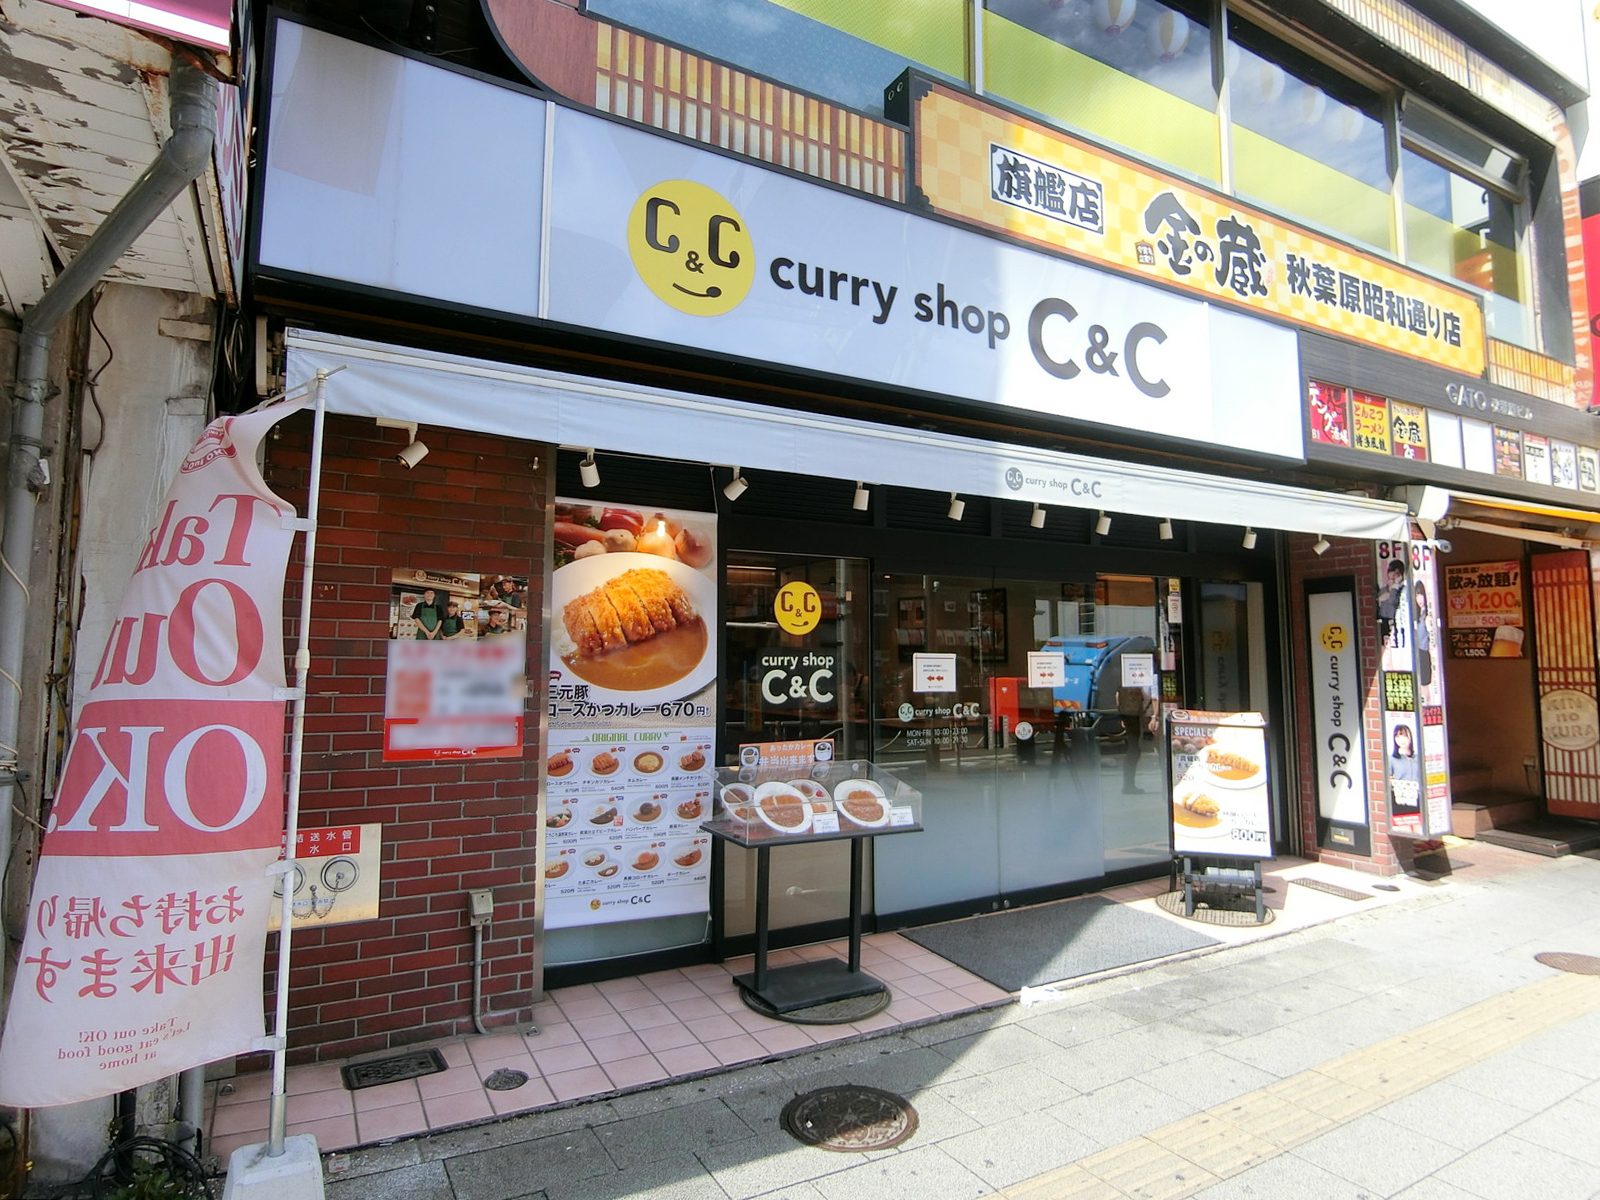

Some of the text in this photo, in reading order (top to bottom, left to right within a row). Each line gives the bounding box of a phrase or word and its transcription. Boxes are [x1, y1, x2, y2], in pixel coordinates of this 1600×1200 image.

[998, 154, 1102, 226] 旗艦店
[646, 196, 742, 275] C&C
[1142, 190, 1270, 299] 金の蔵
[1285, 252, 1462, 349] 秋葉原昭和通り店
[769, 253, 1172, 399] curry shop C&C
[1445, 382, 1487, 411] GATO
[1353, 404, 1385, 422] とんこつ
[1354, 419, 1386, 436] ラーメン
[1403, 443, 1416, 460] 2F
[1025, 477, 1102, 499] curry shop C&C
[1379, 541, 1402, 560] 8F
[1412, 545, 1431, 571] 8F
[1448, 571, 1519, 590] 飲み放題!
[780, 590, 816, 618] C&C
[1451, 633, 1492, 642] プレミアム
[761, 652, 834, 670] curry shop
[549, 684, 589, 700] 三元豚
[761, 668, 834, 705] C&C
[660, 701, 706, 717] 670円
[915, 702, 980, 719] curry shop C&C
[1174, 727, 1206, 737] SPECIAL
[1328, 655, 1353, 790] curry shop C&C
[592, 732, 662, 743] ORIGINAL CURRY
[758, 754, 815, 766] 弁当出来ます
[630, 894, 651, 905] C&C
